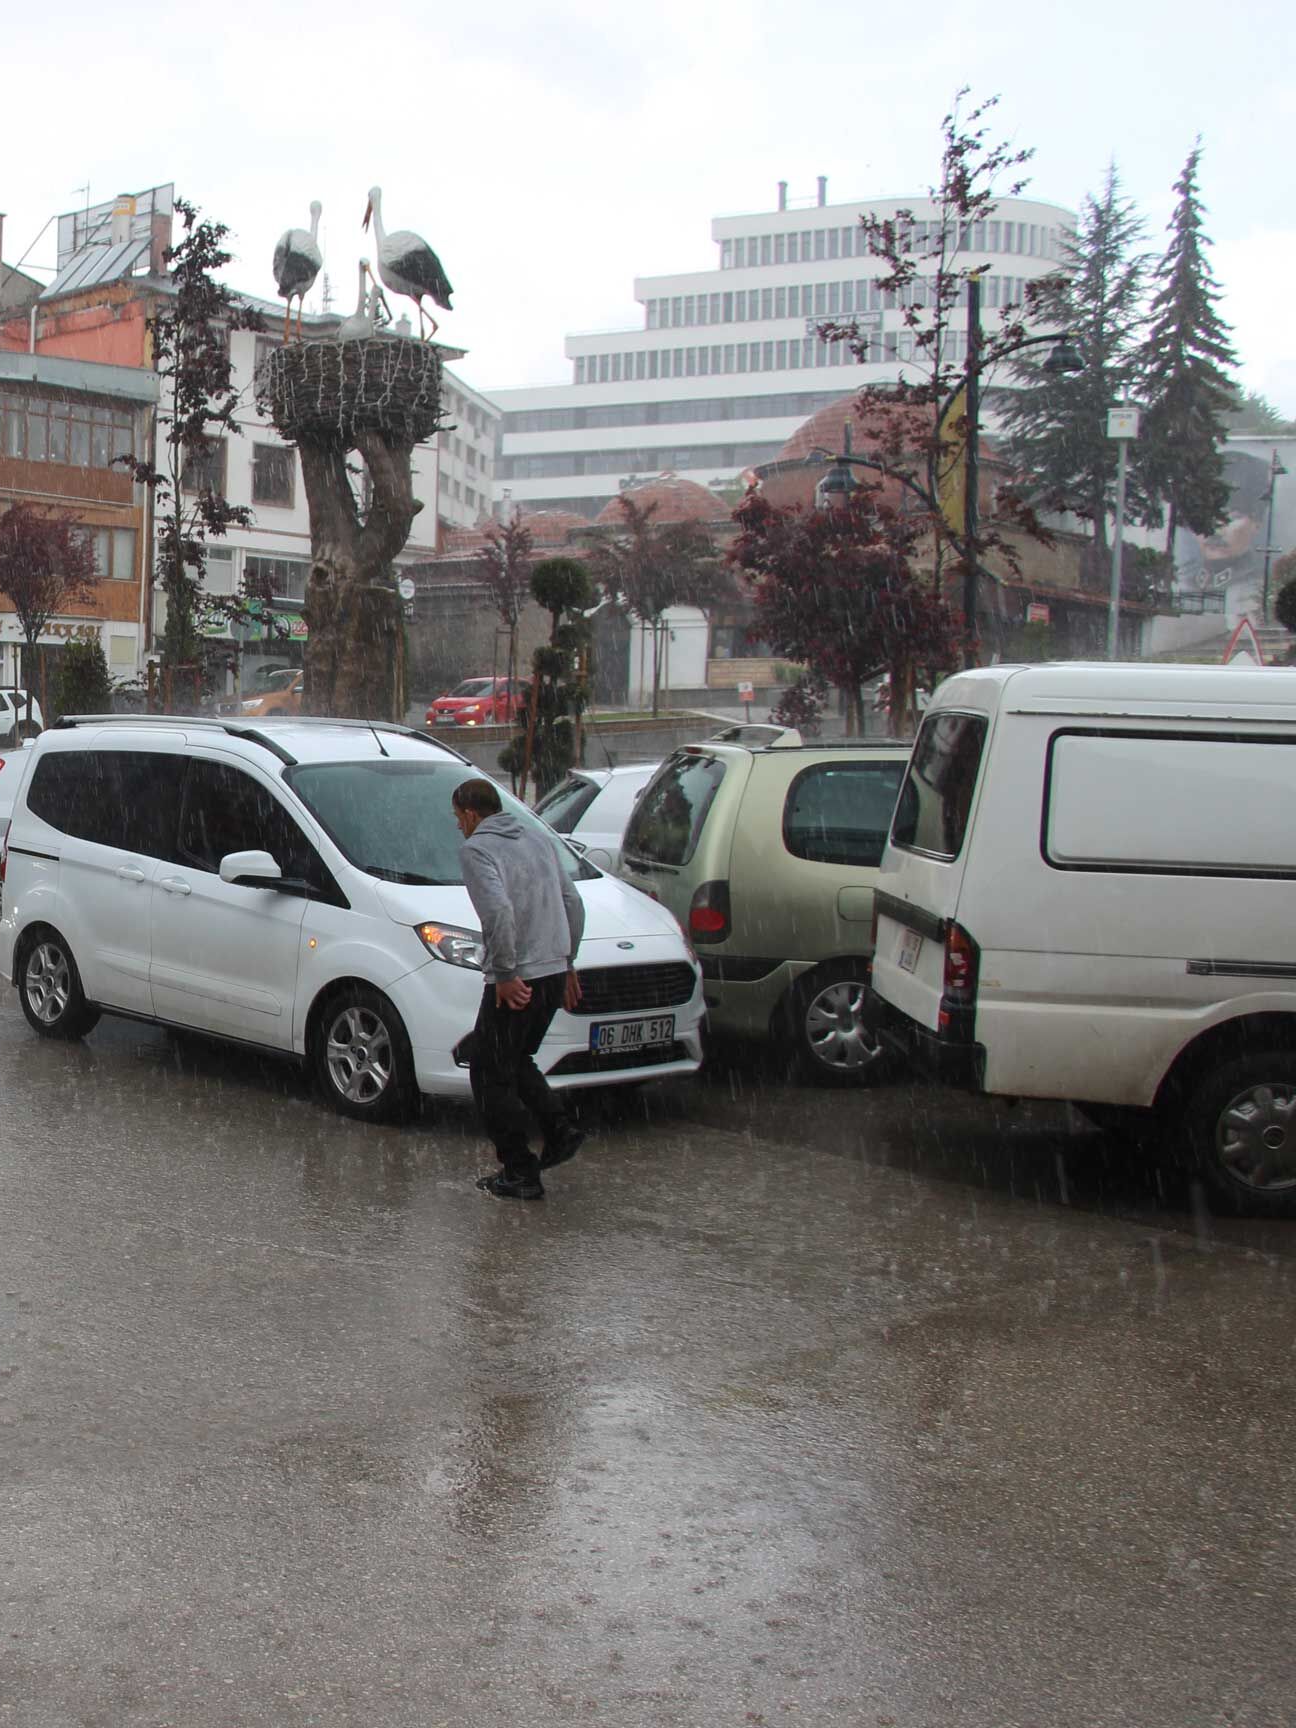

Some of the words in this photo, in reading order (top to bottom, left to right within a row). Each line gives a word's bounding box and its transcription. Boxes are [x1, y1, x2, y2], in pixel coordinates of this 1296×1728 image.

[16, 621, 103, 639] AKKABI
[599, 1026, 615, 1046] 06
[621, 1023, 644, 1044] DHK
[650, 1020, 673, 1040] 512
